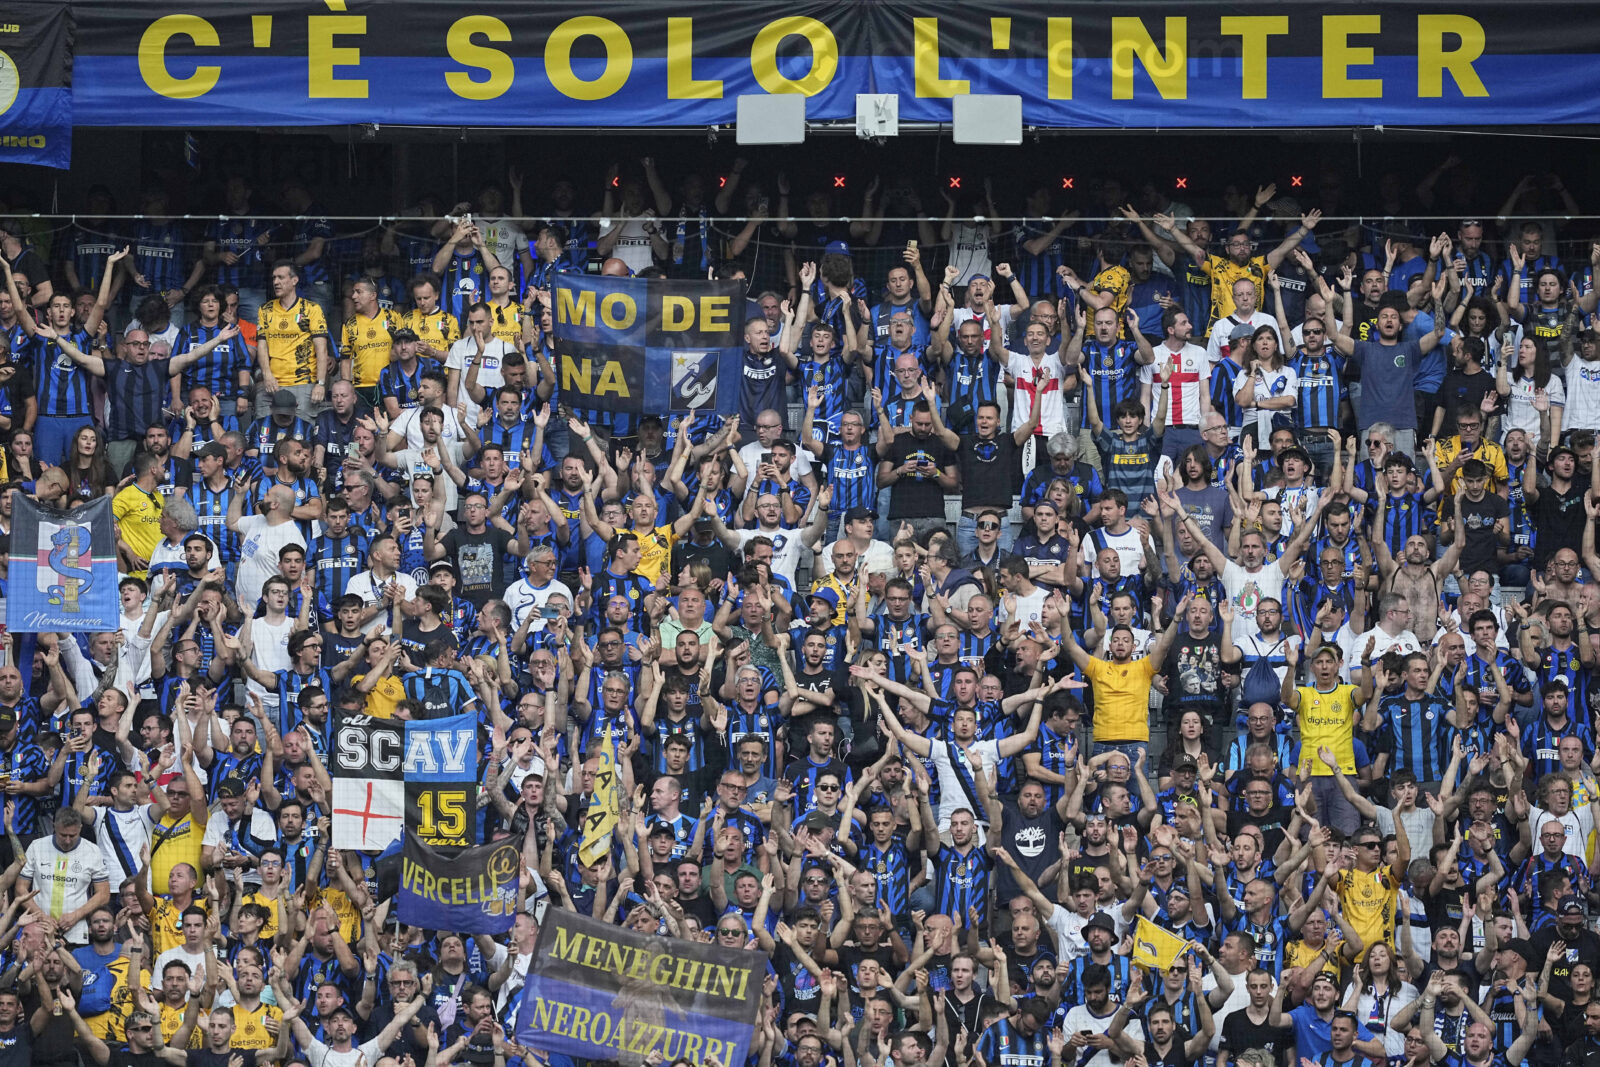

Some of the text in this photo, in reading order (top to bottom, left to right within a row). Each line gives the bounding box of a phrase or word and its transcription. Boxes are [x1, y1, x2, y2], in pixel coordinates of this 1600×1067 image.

[138, 0, 1490, 100] C'È SOLO L'INTER
[0, 134, 46, 149] INO
[137, 245, 174, 259] PIRELLI
[1277, 276, 1305, 292] RELLI
[556, 288, 731, 332] MO DE
[268, 331, 300, 340] betsson
[358, 341, 390, 350] betsson
[561, 355, 630, 398] NA
[742, 365, 777, 380] PIRELLI
[1091, 368, 1124, 376] betsson
[1113, 453, 1149, 465] PIRELLI
[834, 466, 867, 479] PIRELLI
[317, 556, 359, 570] PIRELLI
[341, 714, 372, 726] old
[416, 790, 467, 837] 15
[41, 874, 77, 883] betsson
[402, 856, 498, 905] VERCELLI
[548, 926, 752, 1001] MENEGHINI
[529, 996, 737, 1067] NEROAZZURRI
[230, 1039, 266, 1047] betsson
[1000, 1054, 1044, 1067] PIRELLI
